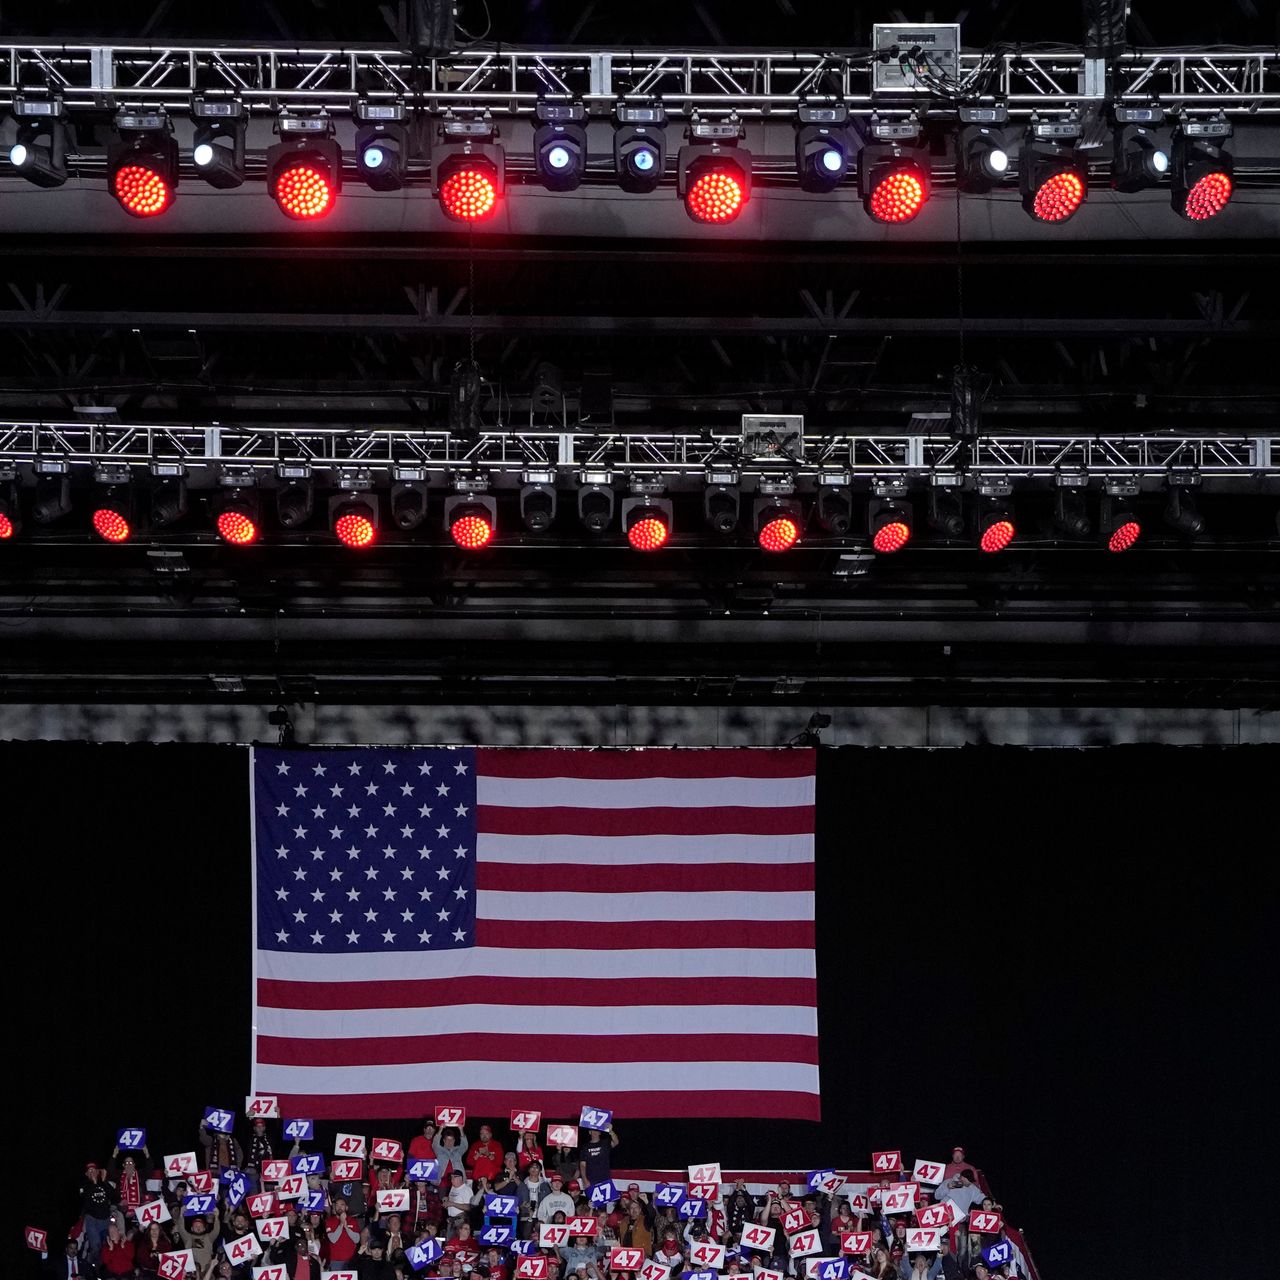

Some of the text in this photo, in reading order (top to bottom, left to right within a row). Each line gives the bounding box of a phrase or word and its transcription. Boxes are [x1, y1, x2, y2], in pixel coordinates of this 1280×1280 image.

[207, 1111, 231, 1128] 47
[438, 1109, 462, 1124] 47
[584, 1112, 608, 1126] 47
[286, 1122, 309, 1136] 47
[120, 1131, 142, 1145] 47
[339, 1138, 362, 1152] 47
[375, 1142, 399, 1158] 47
[876, 1154, 897, 1169] 47
[917, 1164, 940, 1180] 47
[658, 1188, 682, 1203] 47
[186, 1196, 212, 1211] 47
[488, 1198, 514, 1214] 47
[973, 1214, 997, 1229] 47
[746, 1228, 771, 1245] 47
[844, 1235, 868, 1250] 47
[614, 1250, 640, 1266] 47
[520, 1260, 544, 1276] 47
